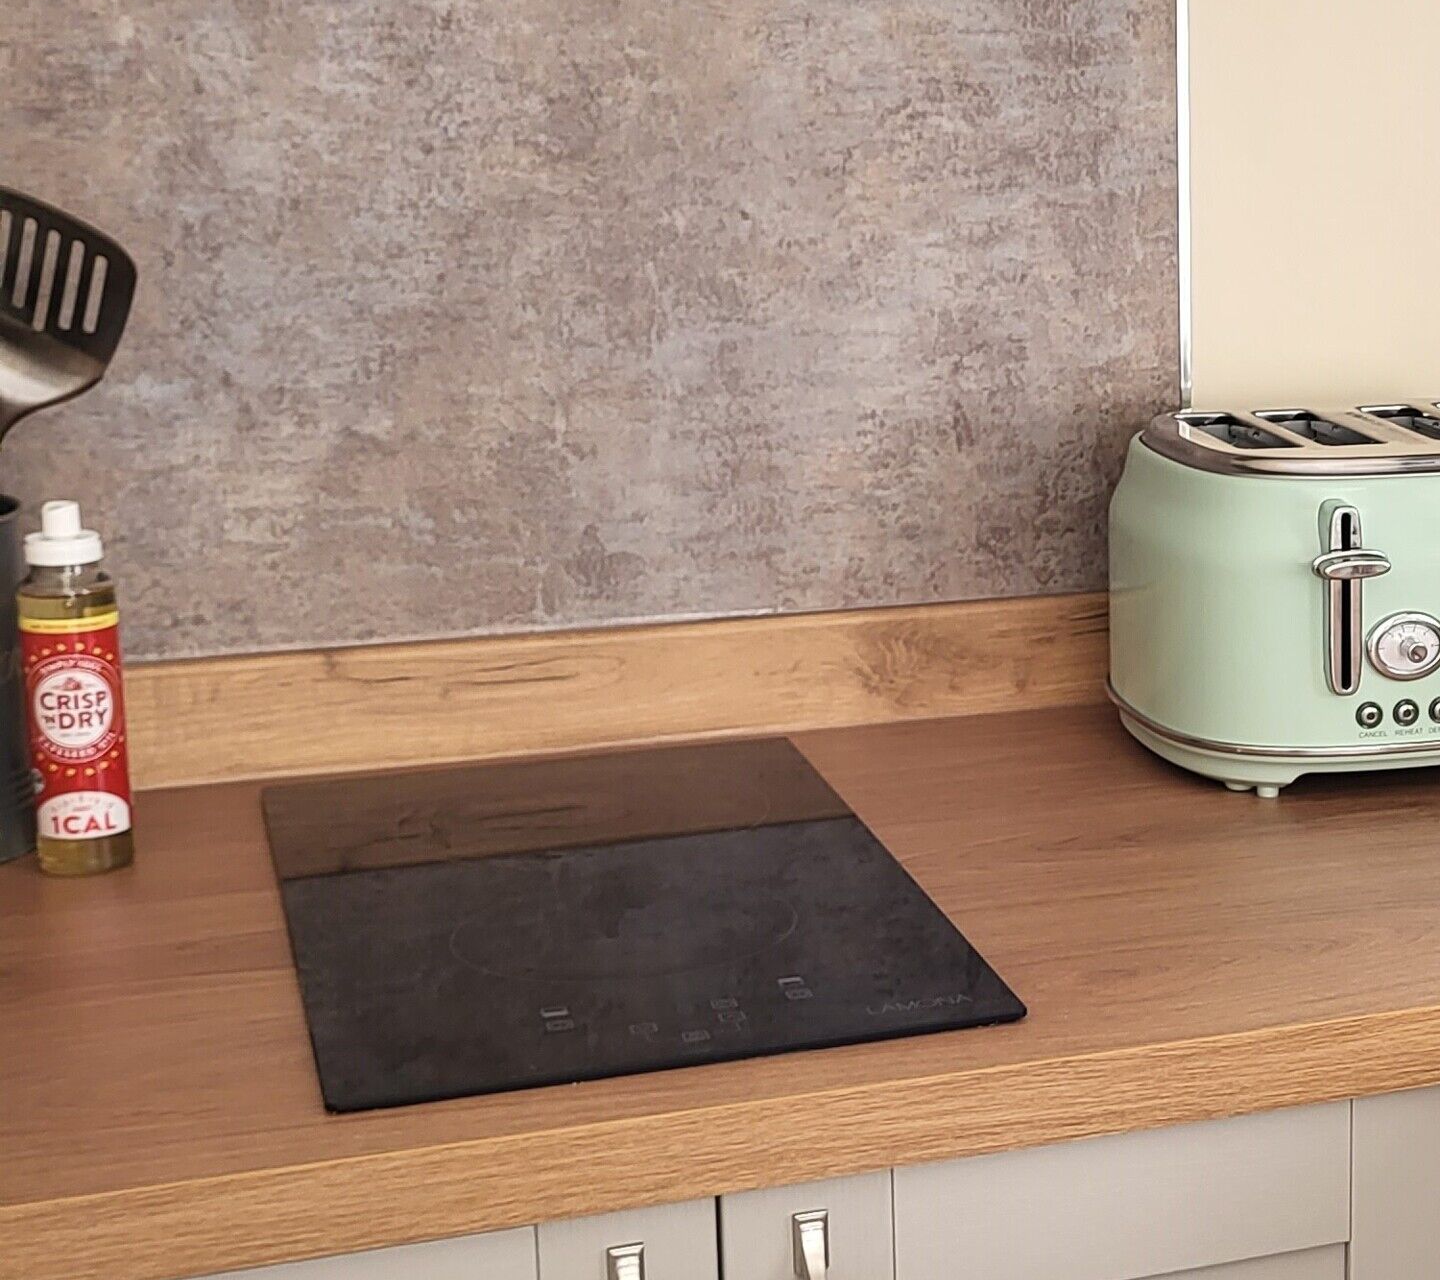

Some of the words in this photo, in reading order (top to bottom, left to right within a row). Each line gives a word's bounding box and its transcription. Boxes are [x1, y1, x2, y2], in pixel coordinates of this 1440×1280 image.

[40, 690, 107, 711] CRISP
[58, 708, 109, 730] DRY
[1358, 730, 1388, 739] CANCEL
[1394, 727, 1424, 737] REHEAT
[865, 993, 973, 1016] LAMONA
